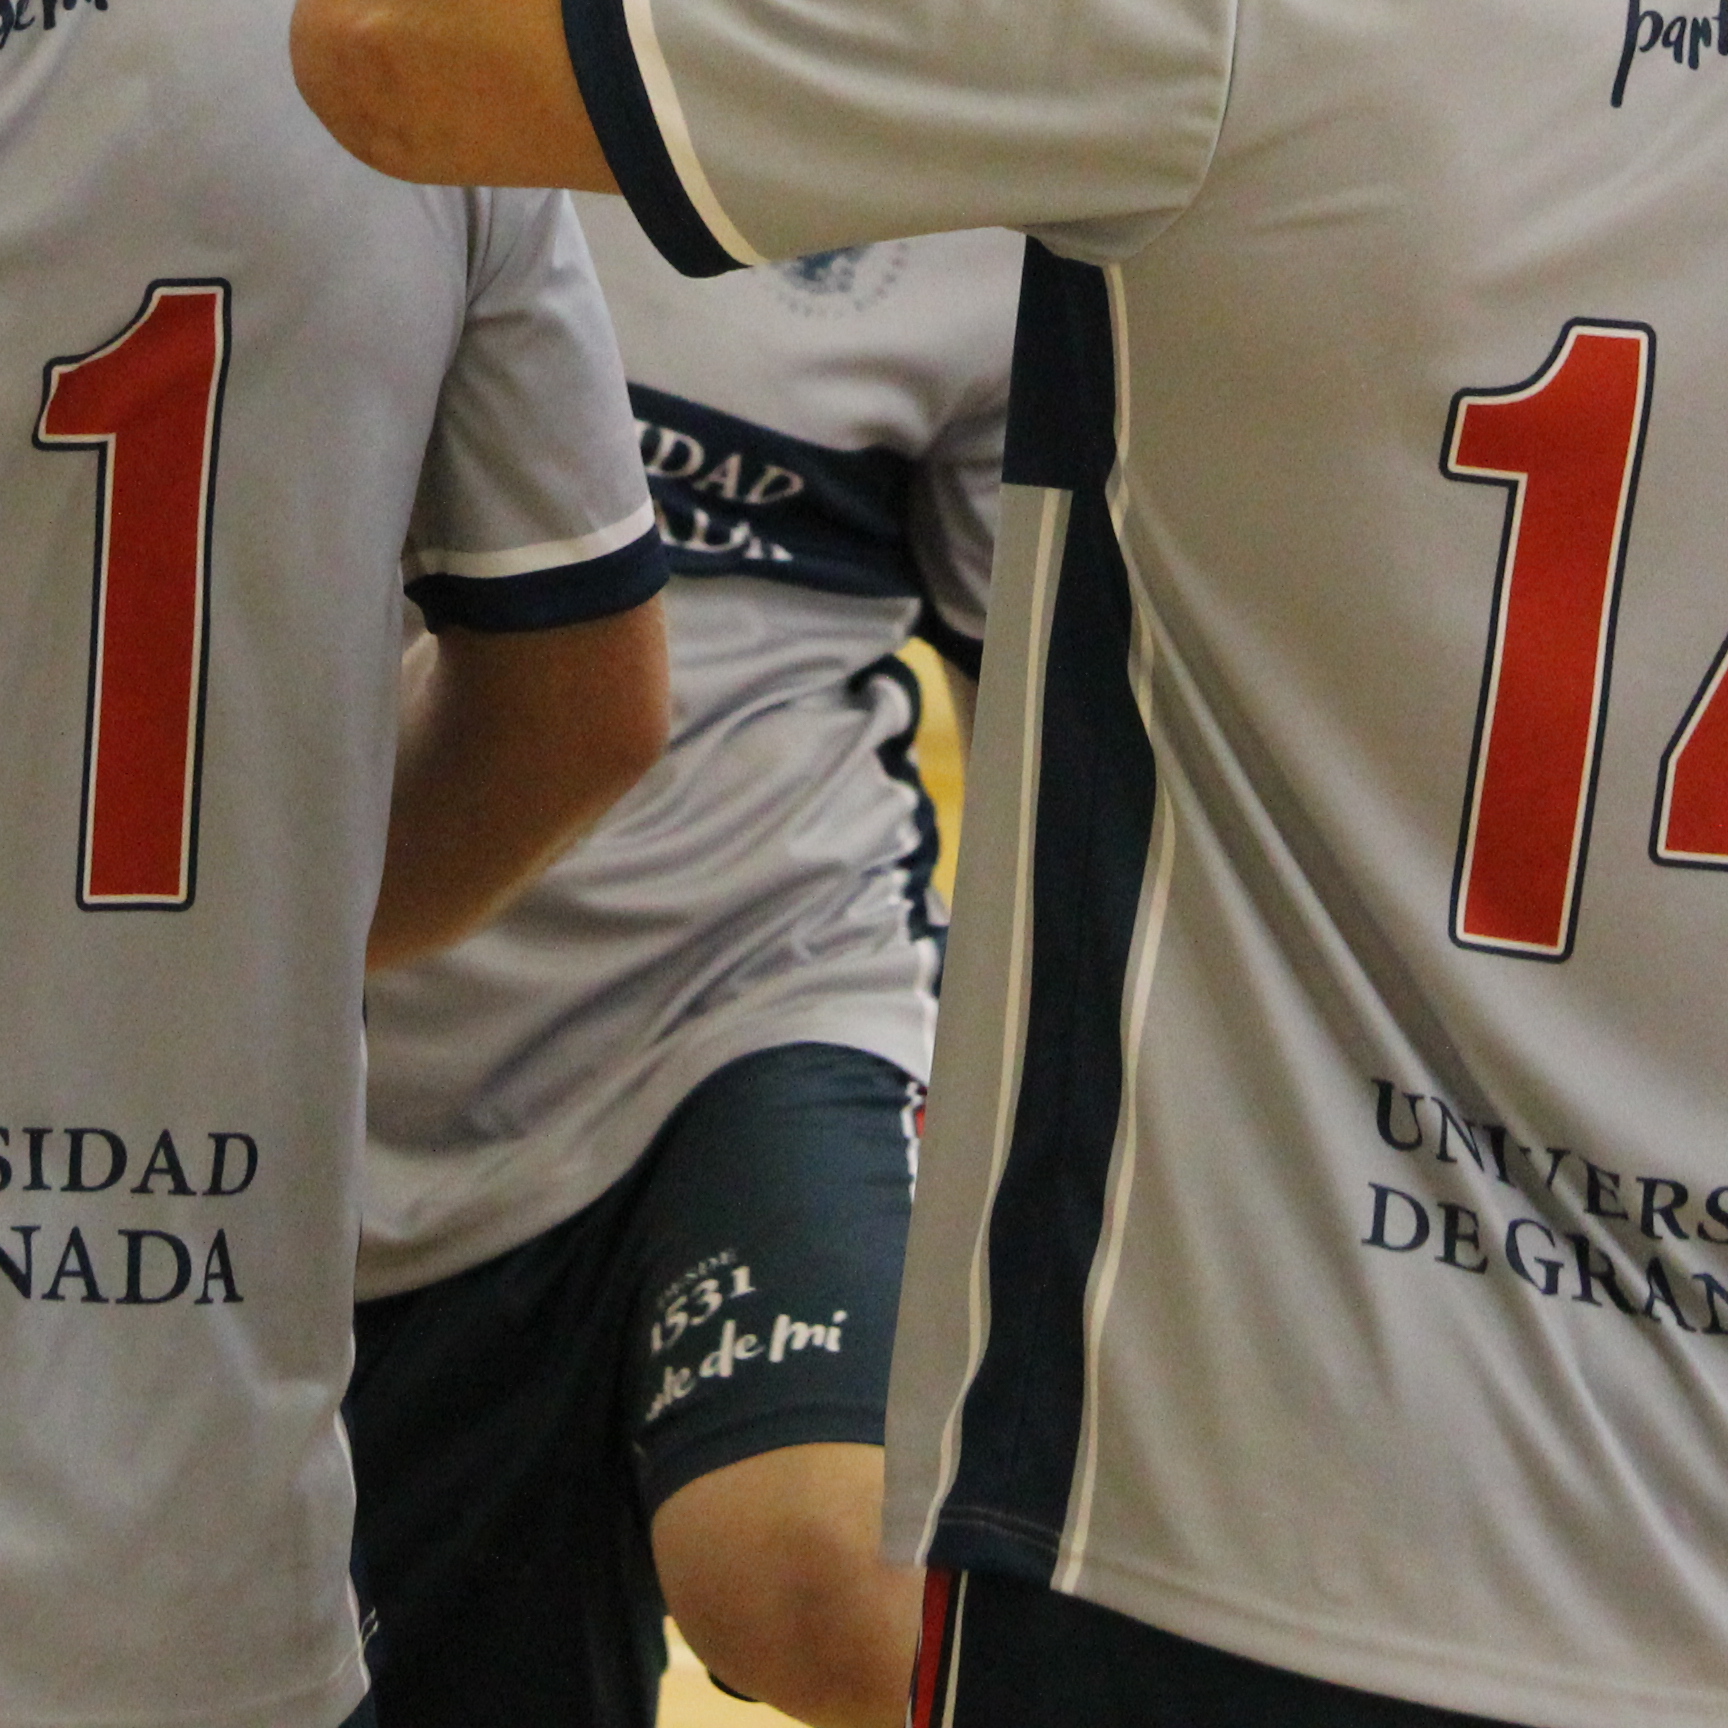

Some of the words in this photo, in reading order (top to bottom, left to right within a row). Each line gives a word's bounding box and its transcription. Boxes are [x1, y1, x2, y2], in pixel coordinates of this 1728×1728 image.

[1361, 1180, 1488, 1273] DE
[699, 1320, 765, 1378] de
[769, 1310, 848, 1363] mi
